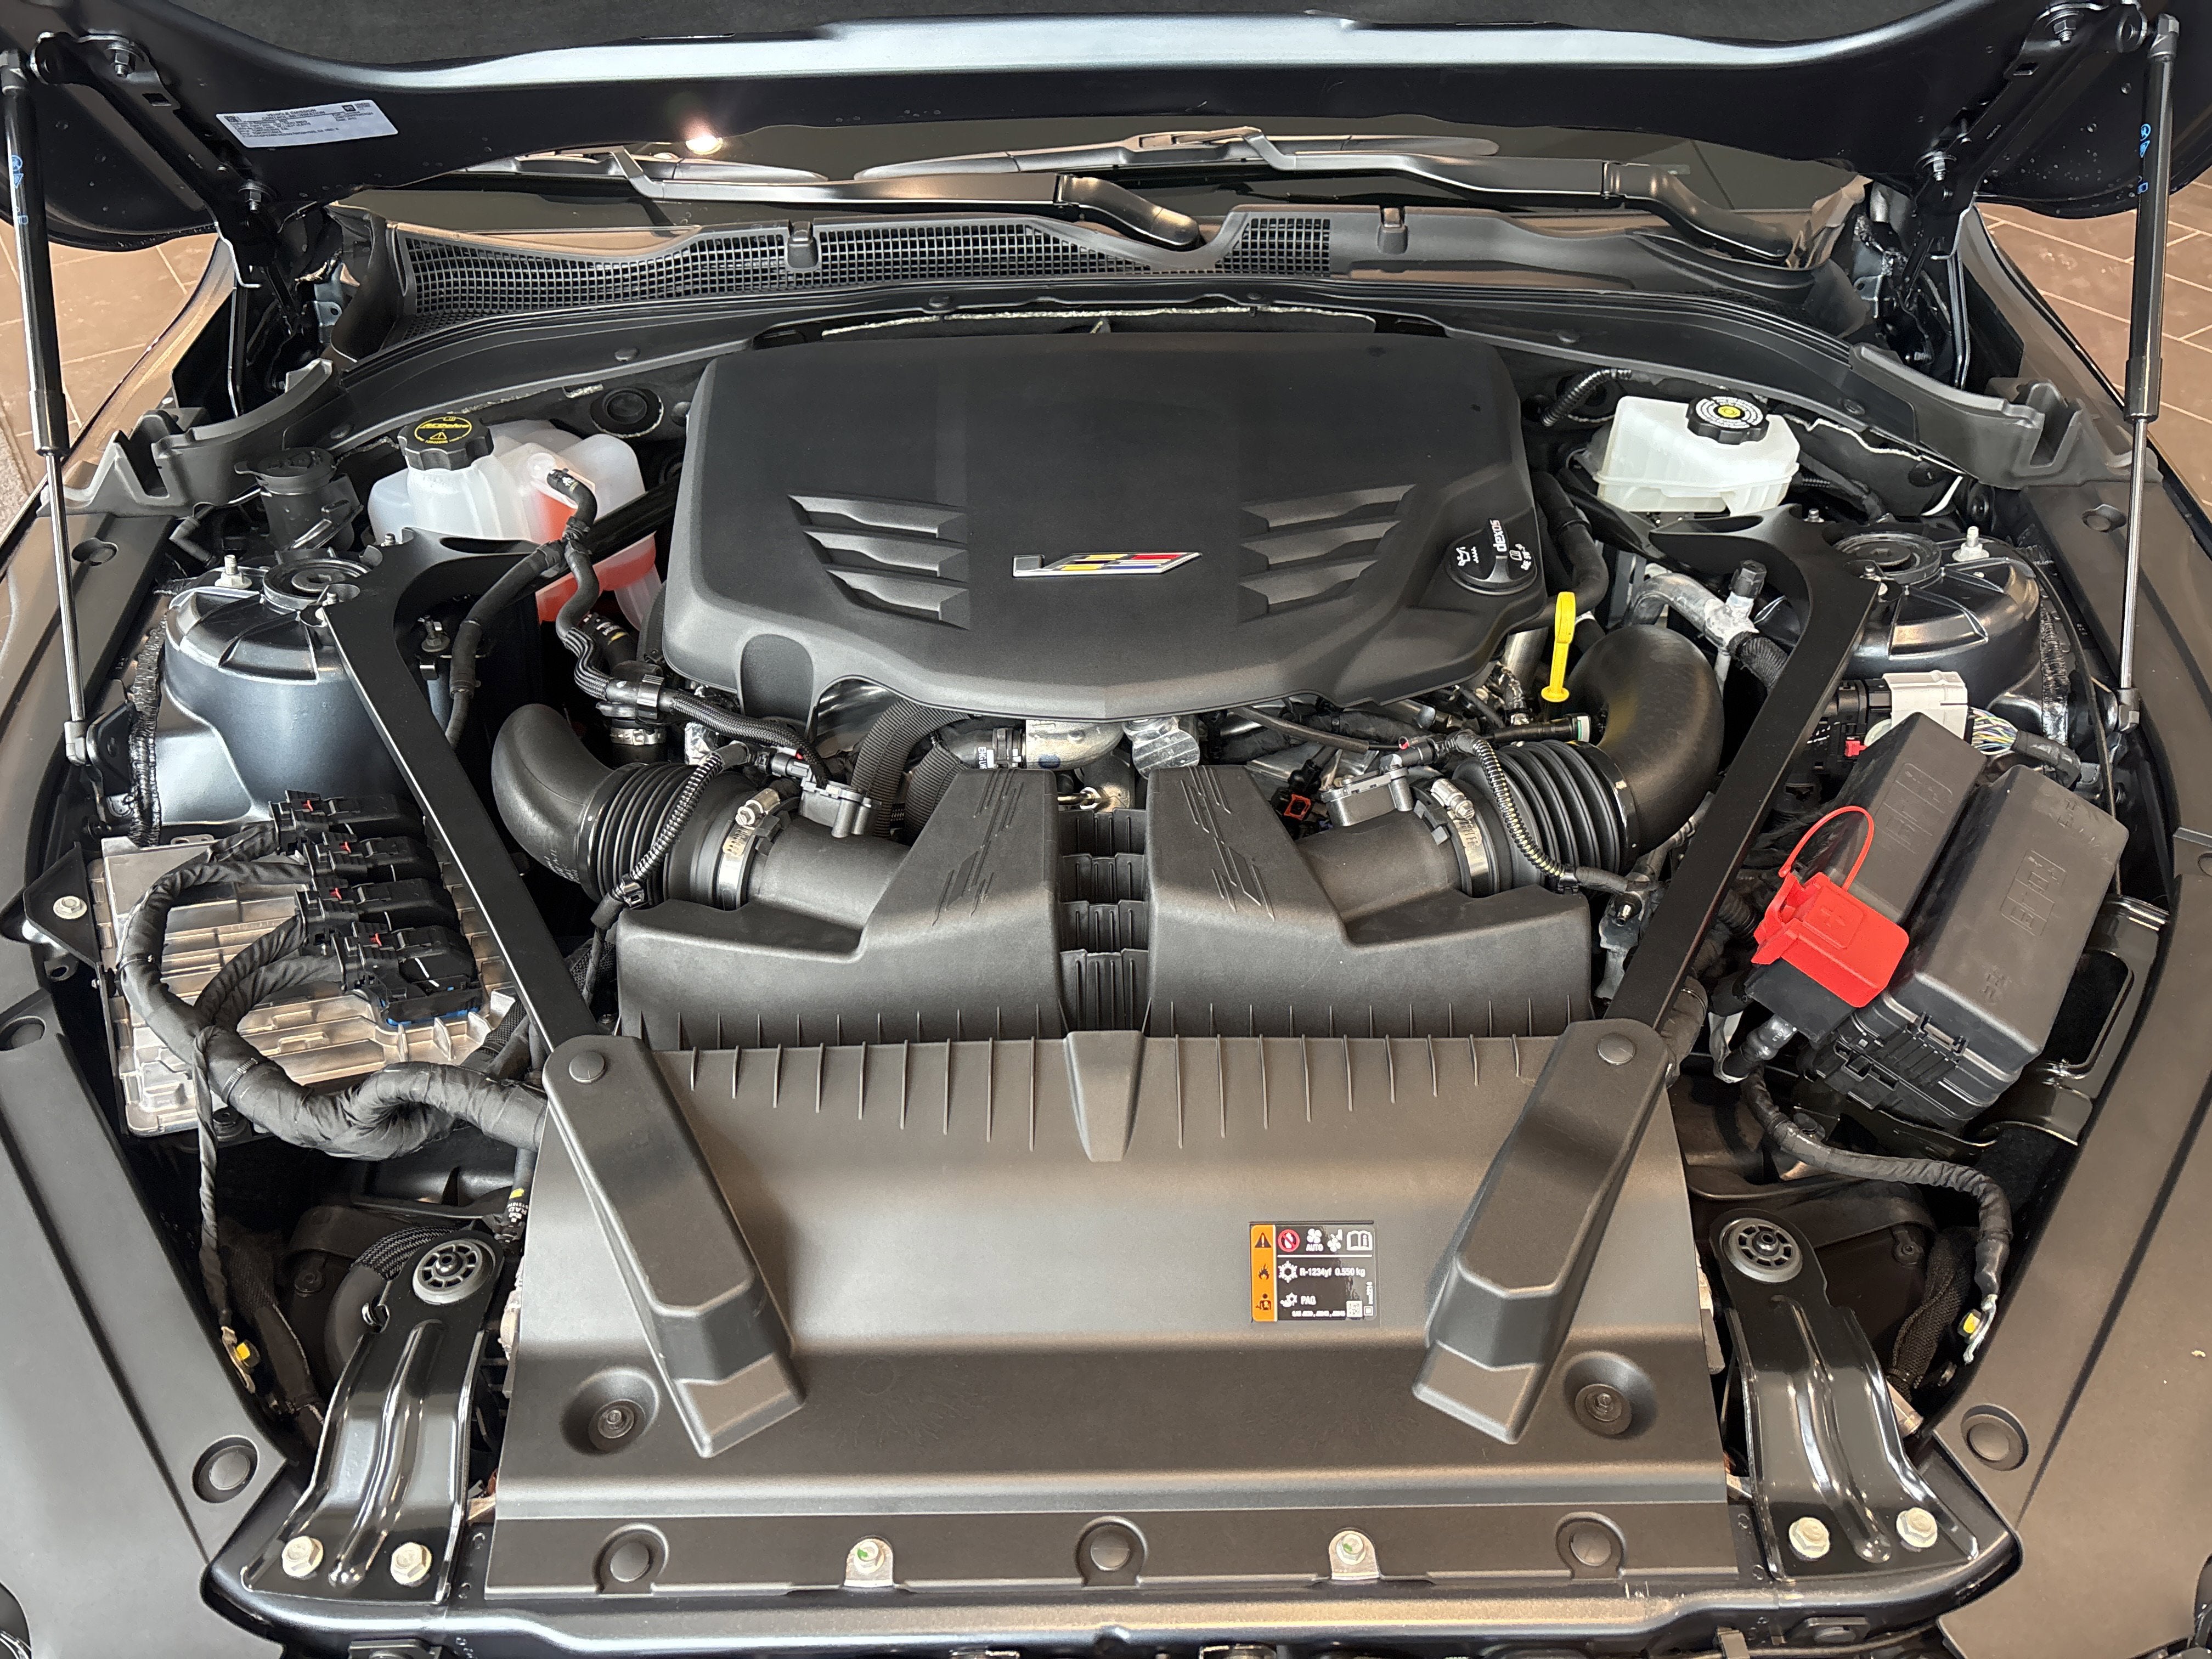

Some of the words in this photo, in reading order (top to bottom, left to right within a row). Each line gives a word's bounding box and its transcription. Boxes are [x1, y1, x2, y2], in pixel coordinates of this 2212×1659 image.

[1489, 519, 1507, 552] dexos
[978, 747, 986, 760] ENG
[508, 1206, 527, 1215] RAD
[1306, 1243, 1324, 1252] AUTO
[1299, 1268, 1332, 1278] R-1234yf
[1334, 1267, 1355, 1277] 0.550
[1356, 1267, 1366, 1278] kg
[1300, 1295, 1317, 1305] PAG
